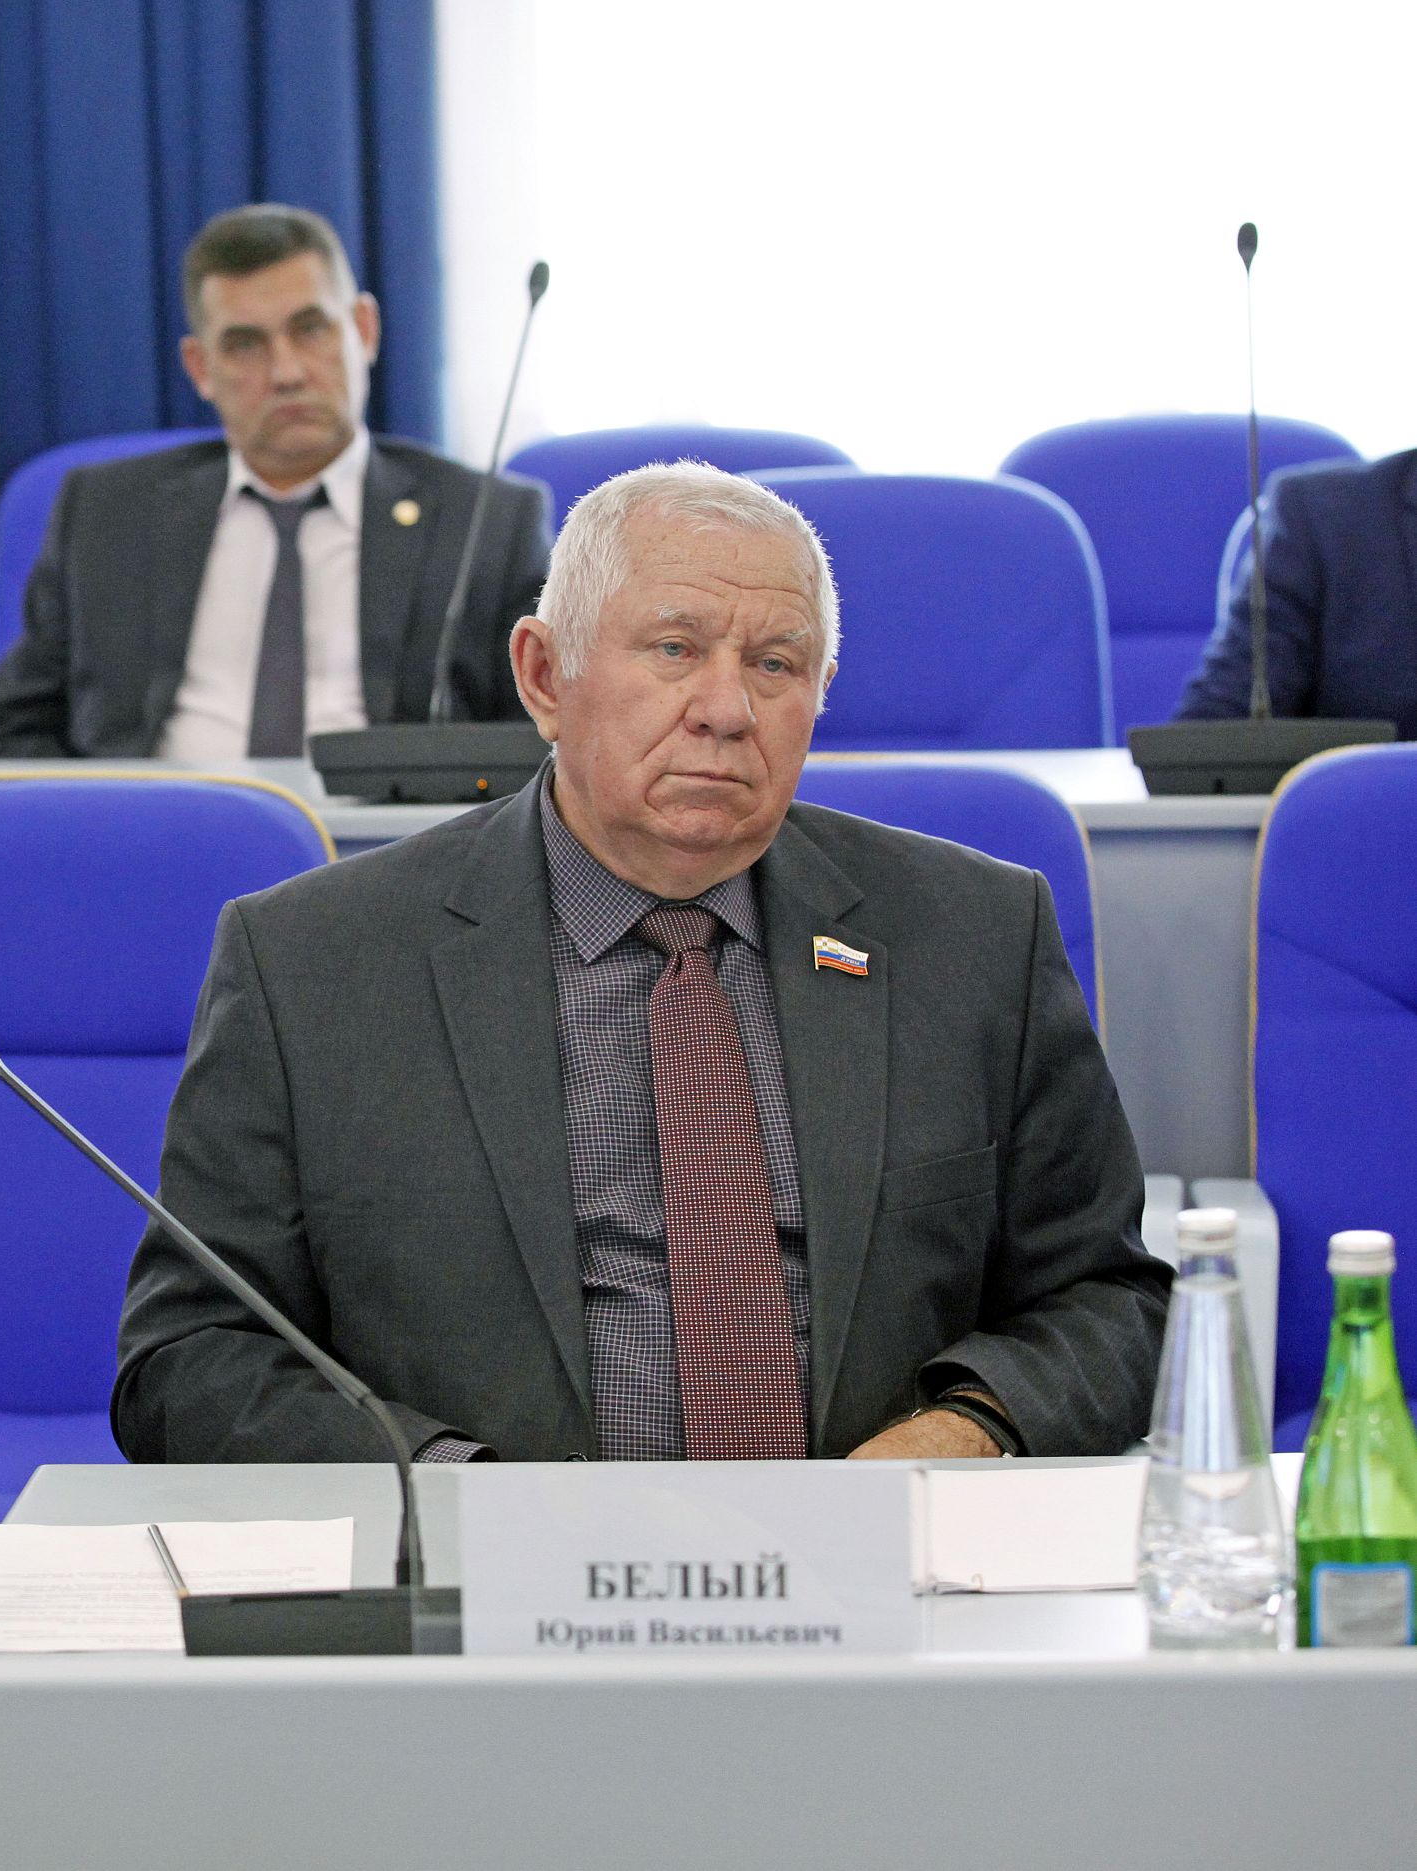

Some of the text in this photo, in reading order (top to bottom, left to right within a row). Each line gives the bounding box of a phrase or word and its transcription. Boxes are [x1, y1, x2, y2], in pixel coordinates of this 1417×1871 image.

[586, 1552, 787, 1600] БЕЛЫЙ
[536, 1619, 841, 1652] Юрий Васильевич
